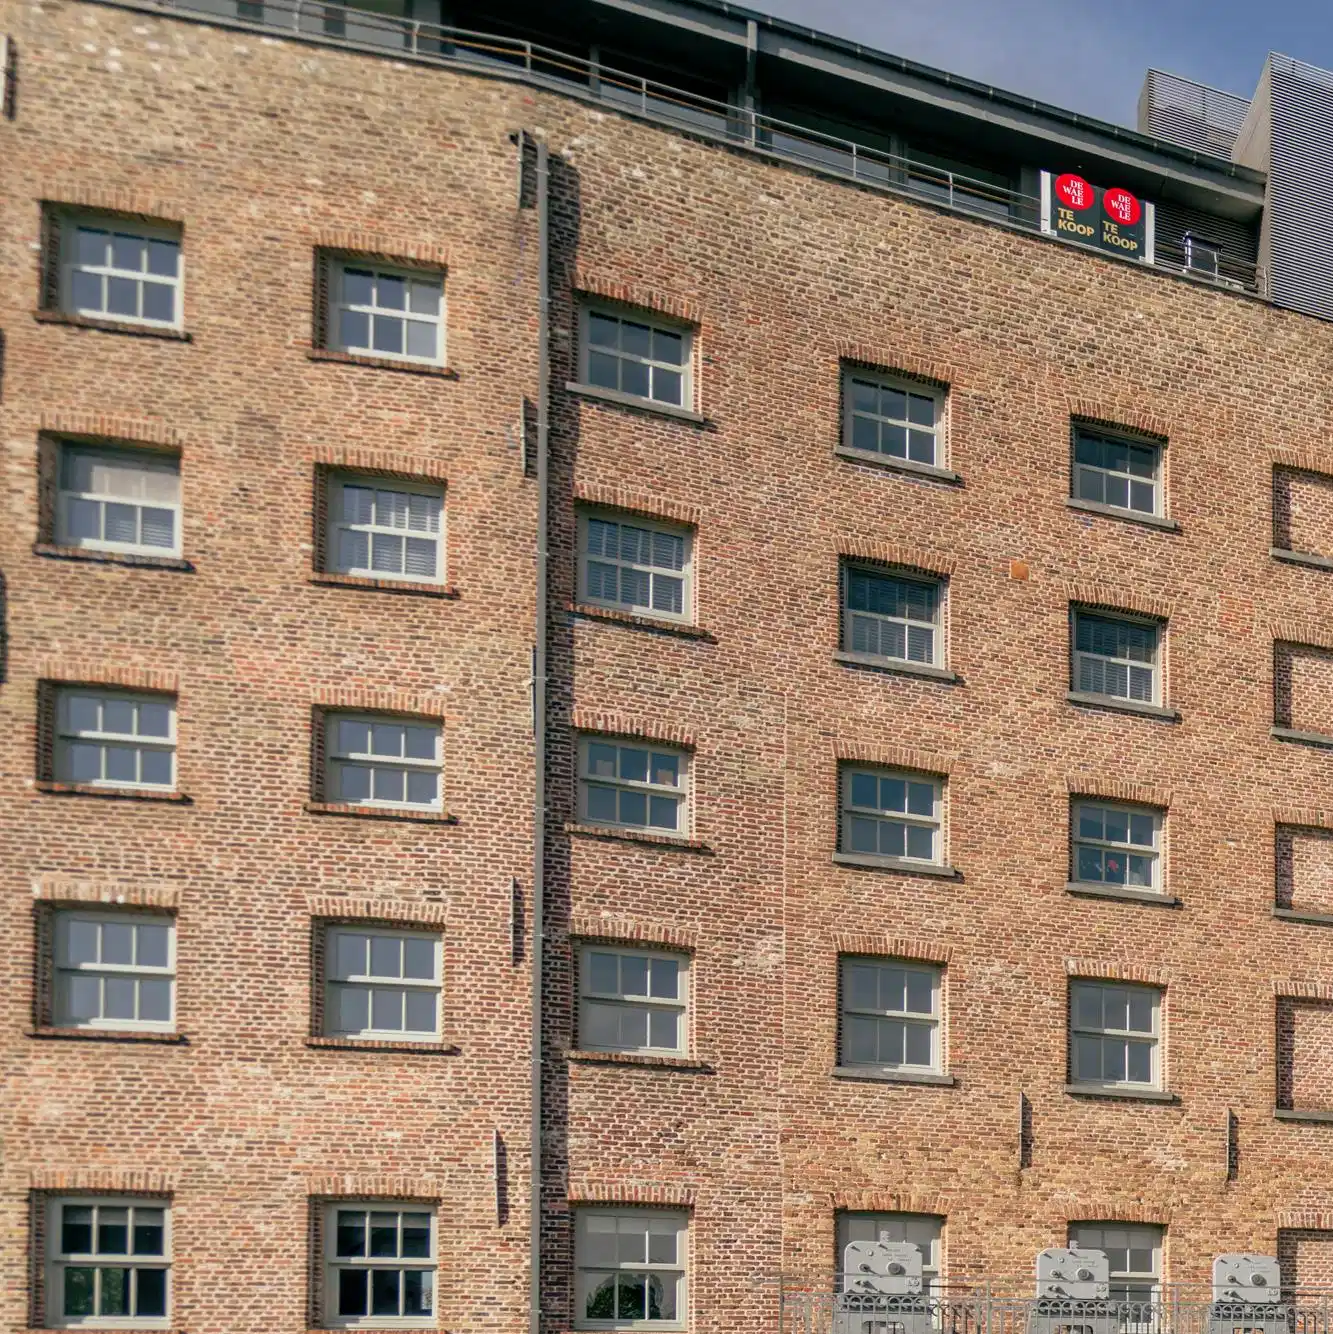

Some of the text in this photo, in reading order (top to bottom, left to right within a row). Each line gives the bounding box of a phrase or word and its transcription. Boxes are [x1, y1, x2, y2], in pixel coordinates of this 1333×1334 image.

[1070, 179, 1084, 189] DE
[1062, 185, 1084, 197] WAE
[1071, 195, 1084, 206] LE
[1118, 194, 1131, 204] DE
[1110, 199, 1131, 212] WAE
[1058, 207, 1074, 220] TE
[1119, 210, 1131, 221] LE
[1058, 219, 1095, 237] KOOP
[1103, 220, 1118, 234] TE
[1103, 232, 1138, 251] KOOP
